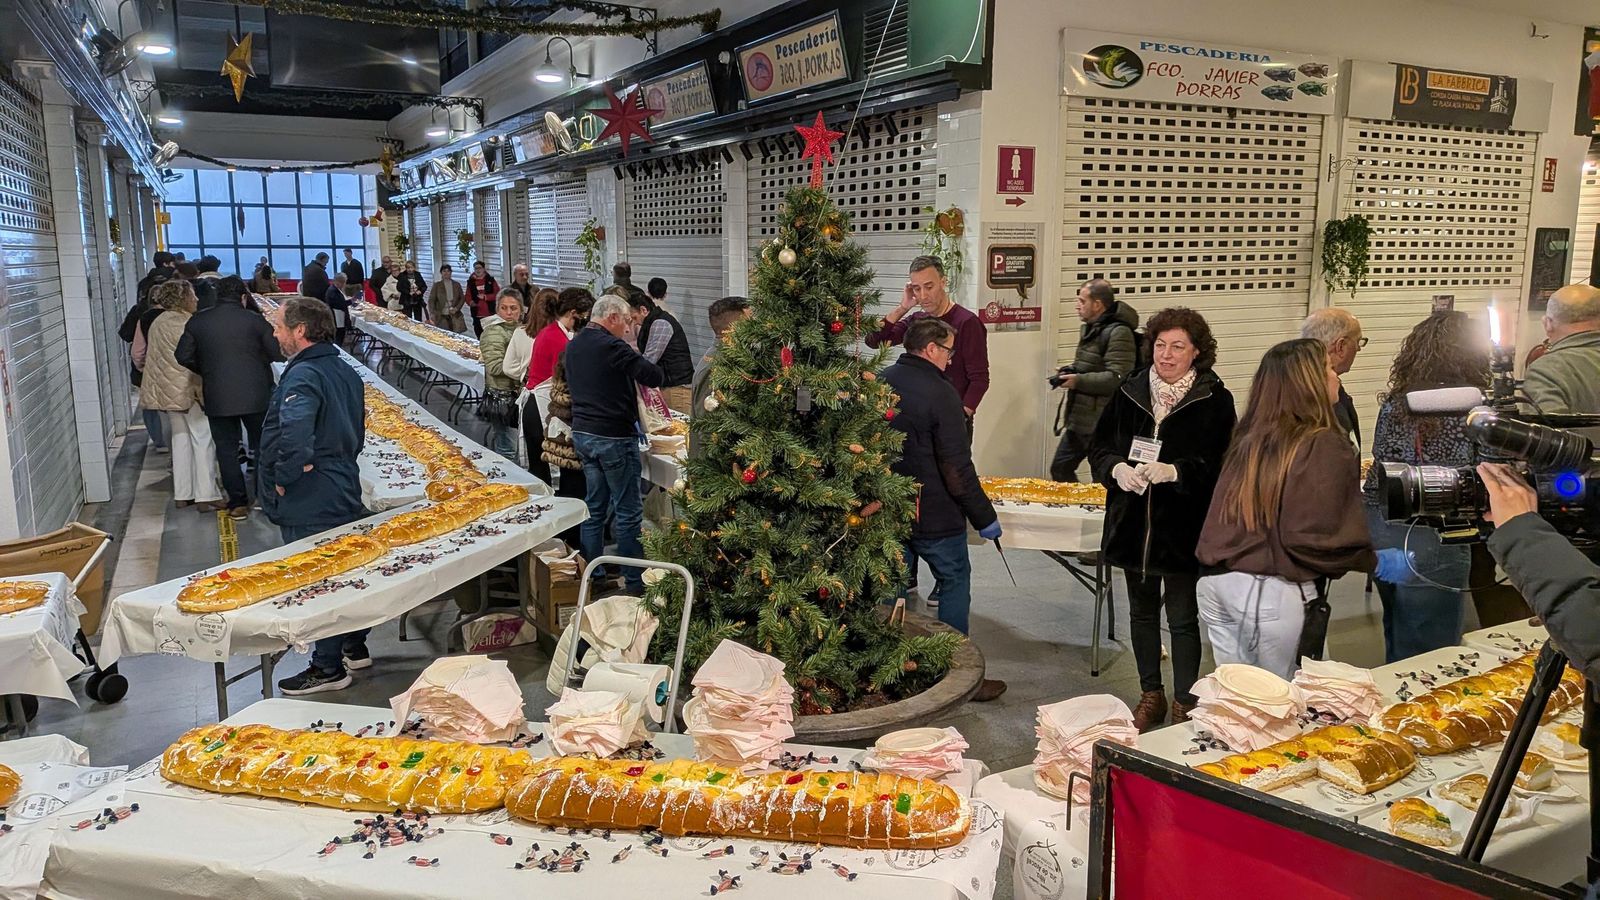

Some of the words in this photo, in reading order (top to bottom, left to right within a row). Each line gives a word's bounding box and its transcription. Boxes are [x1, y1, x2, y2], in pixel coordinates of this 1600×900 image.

[775, 27, 838, 60] Pescadería
[1139, 41, 1272, 63] PESCADERIA
[1146, 62, 1185, 79] FCO.
[1204, 67, 1260, 86] JAVIER
[1432, 74, 1443, 86] LA
[1446, 76, 1488, 91] FABBRICA
[1175, 81, 1242, 101] PORRAS
[993, 255, 1004, 269] P
